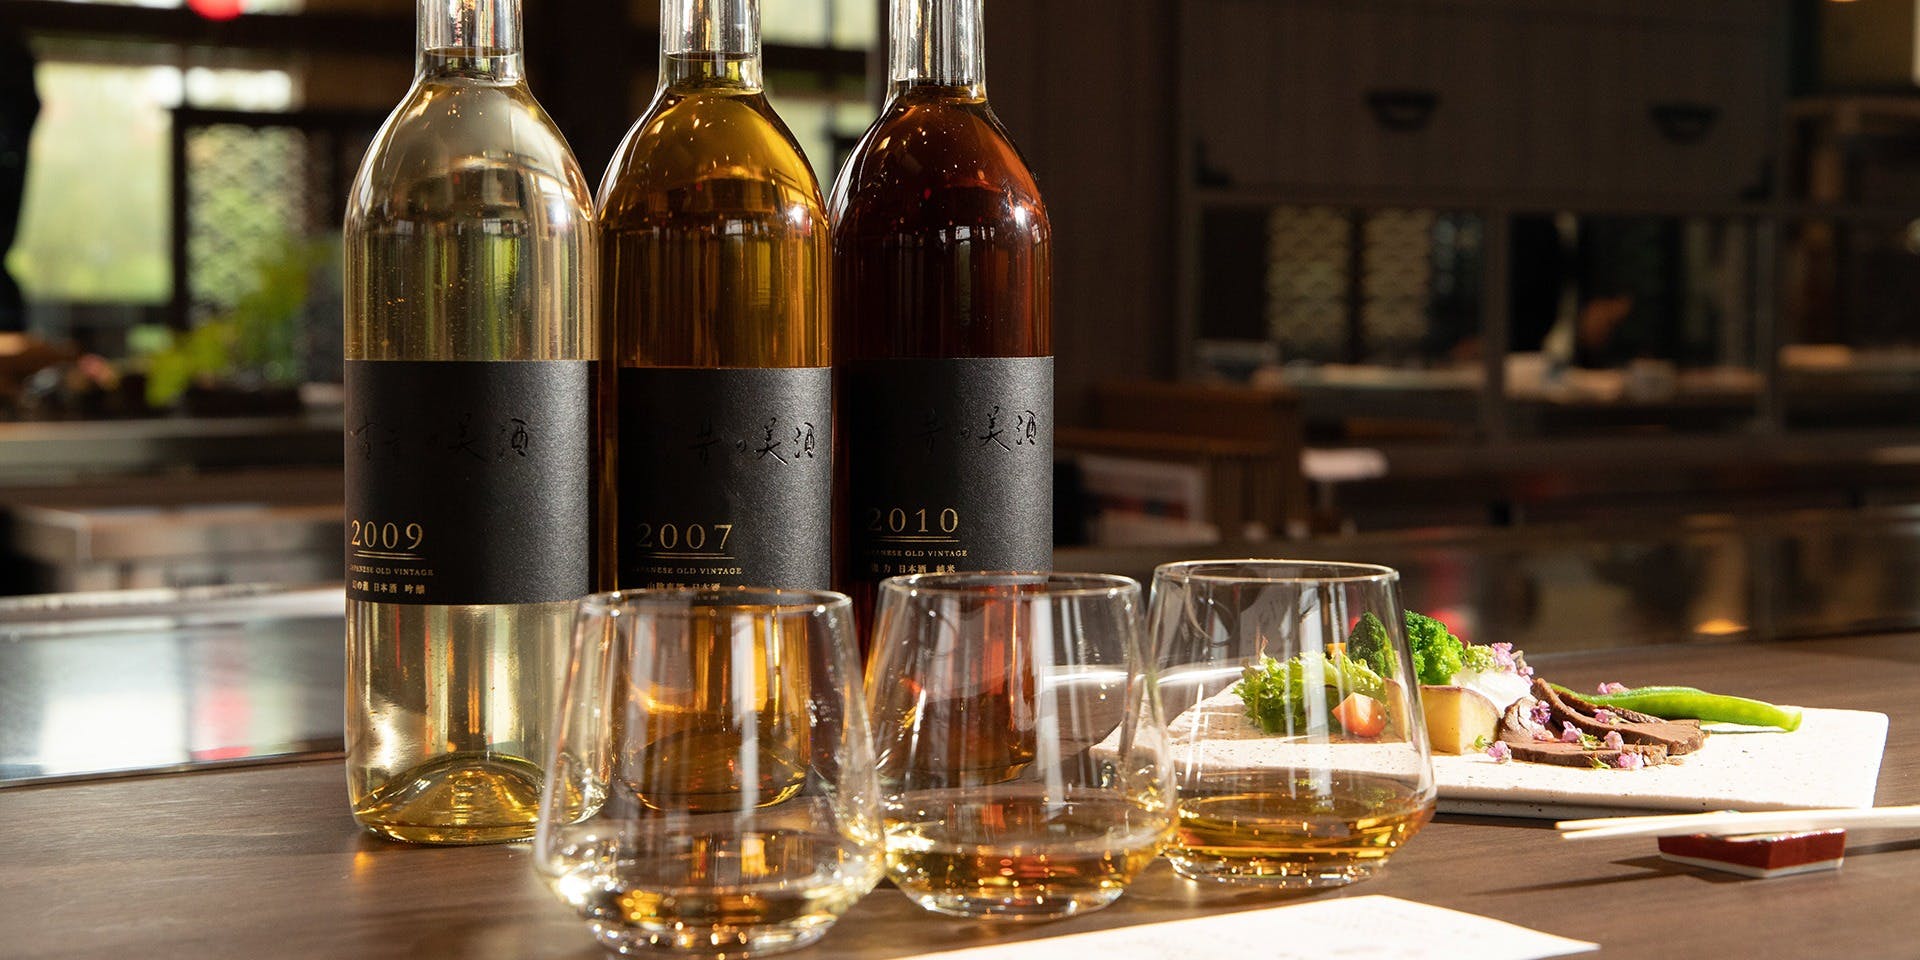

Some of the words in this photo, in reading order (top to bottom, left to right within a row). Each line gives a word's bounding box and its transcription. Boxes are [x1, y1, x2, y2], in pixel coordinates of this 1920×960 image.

[867, 507, 959, 533] 2010
[351, 519, 423, 550] 2009
[638, 523, 733, 550] 2007
[927, 549, 969, 557] VINTAGE
[375, 567, 392, 575] OLD
[394, 568, 435, 577] VINTAGE
[676, 567, 697, 575] OLD
[699, 567, 743, 575] VINTAGE
